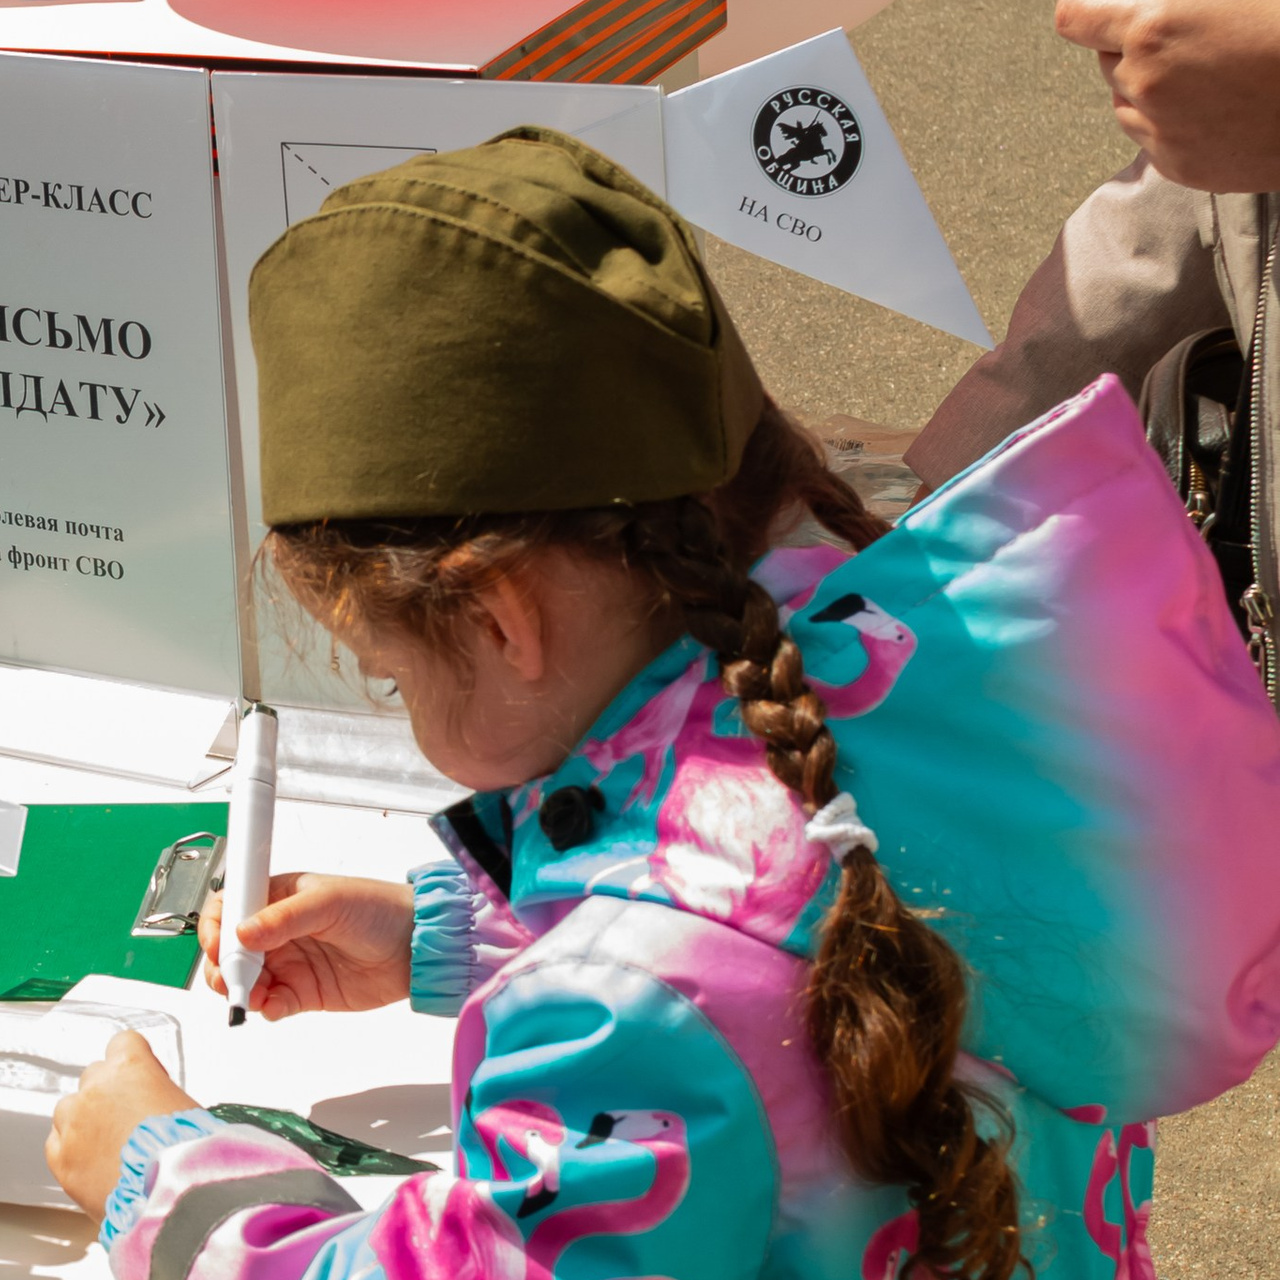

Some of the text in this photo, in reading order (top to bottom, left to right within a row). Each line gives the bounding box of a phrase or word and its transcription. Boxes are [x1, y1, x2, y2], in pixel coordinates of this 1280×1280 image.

[770, 89, 860, 142] РУССКАЯ
[757, 145, 839, 194] ОБЩИНА
[738, 196, 823, 243] НА СВО
[65, 519, 125, 543] почта
[7, 546, 70, 573] фронт
[75, 556, 125, 581] СВО
